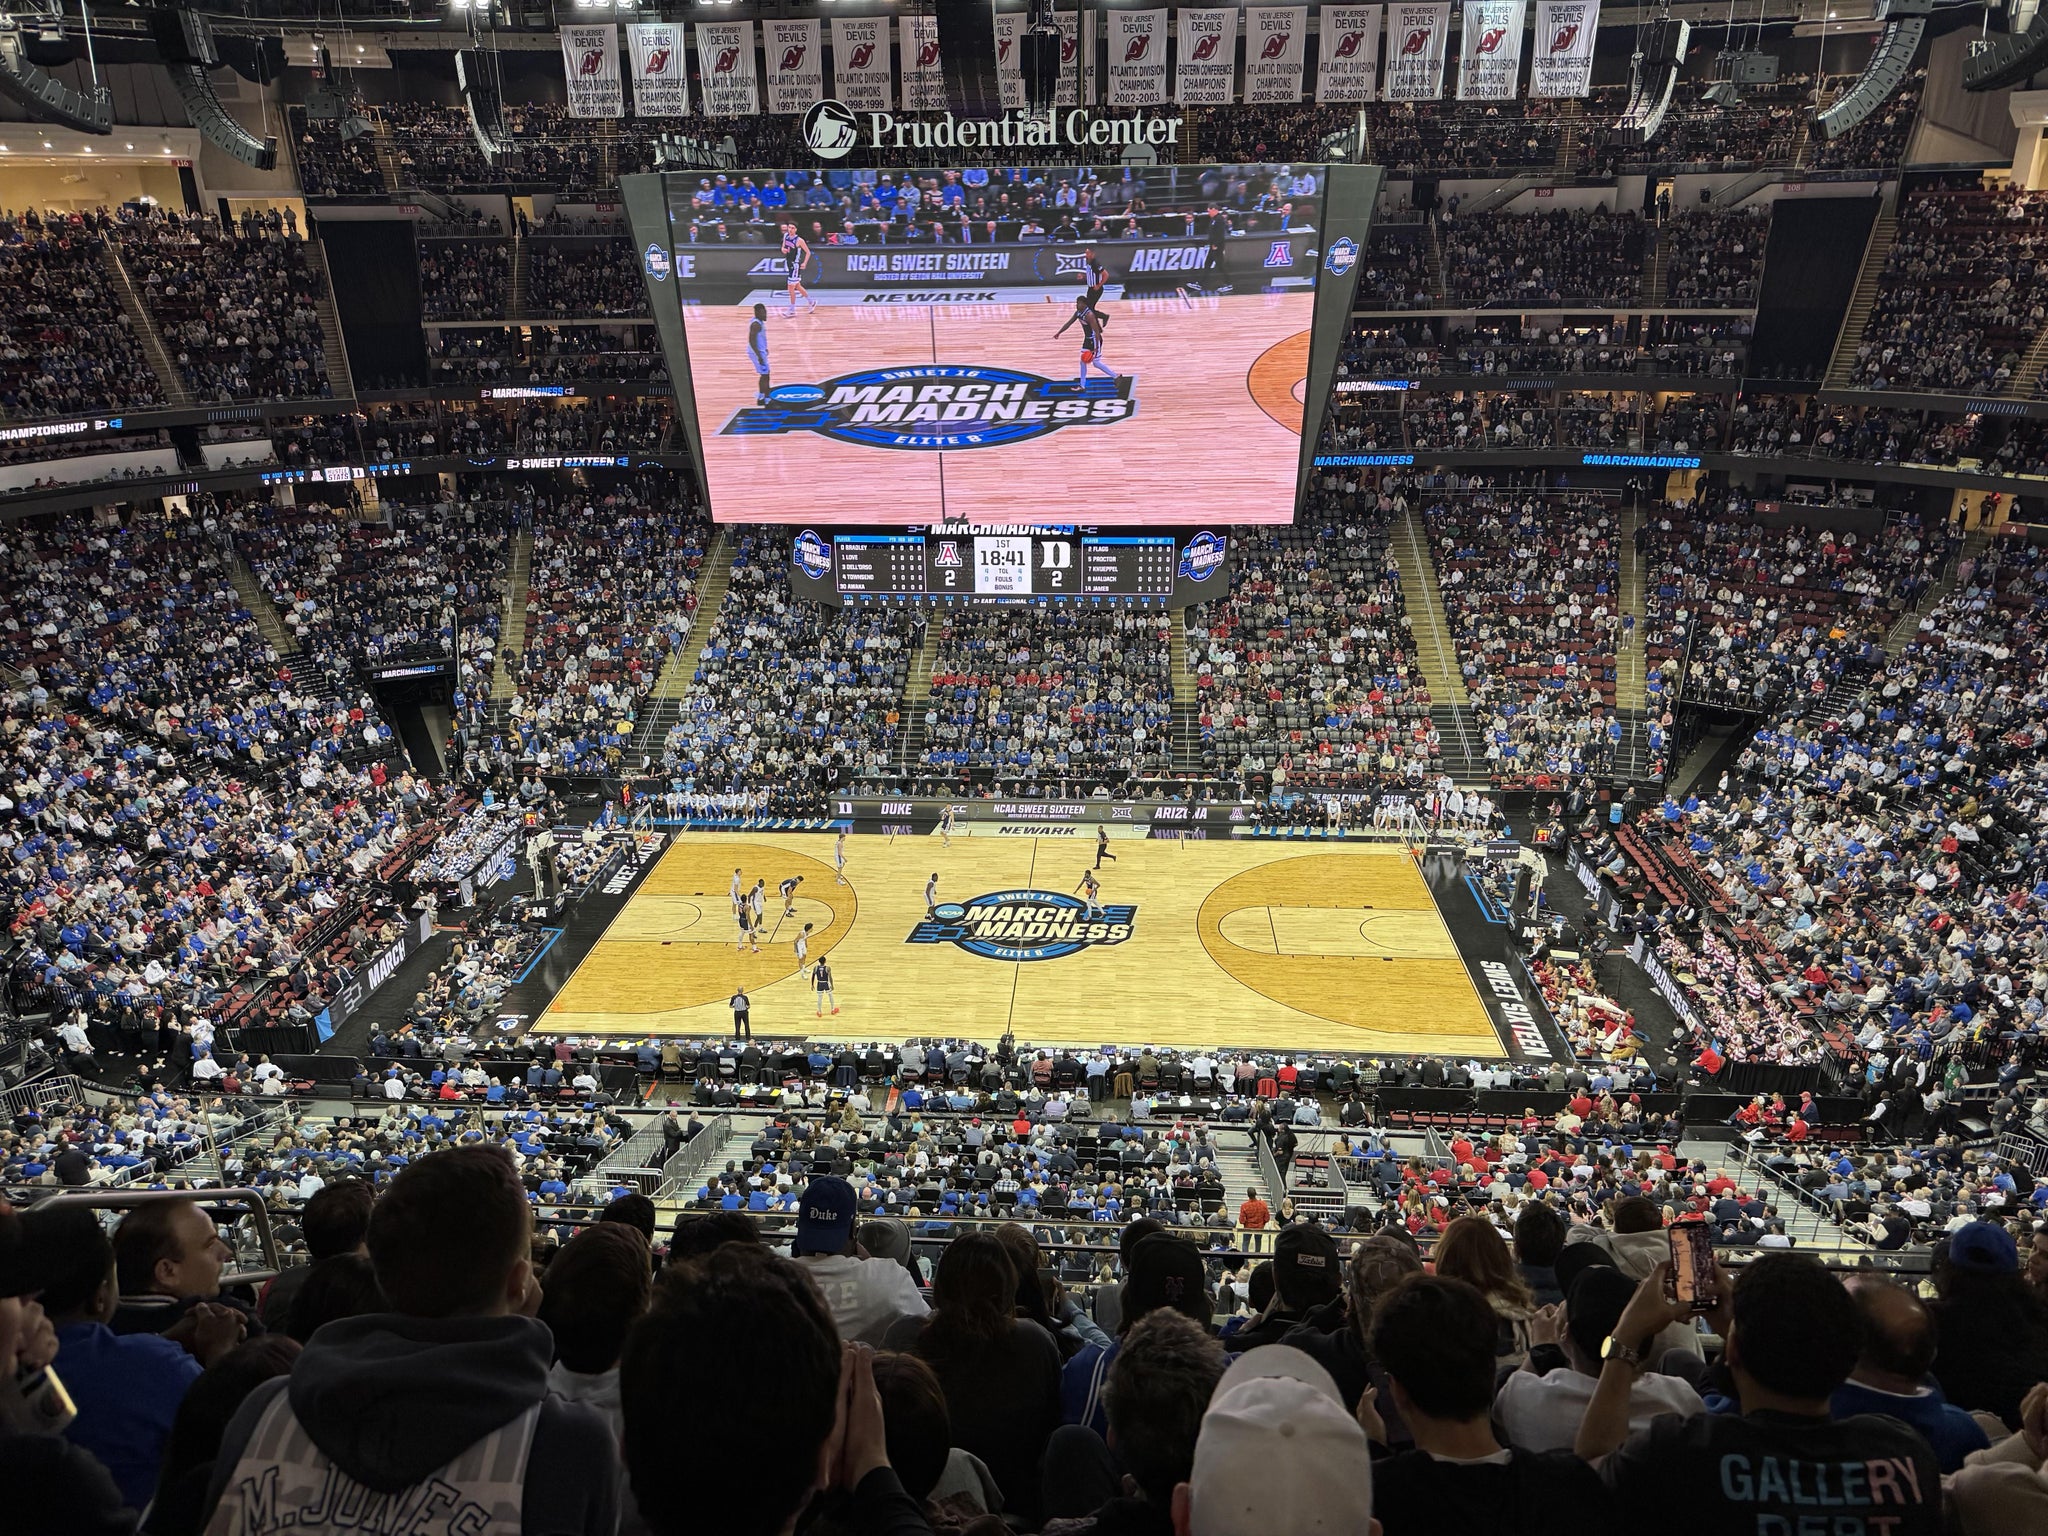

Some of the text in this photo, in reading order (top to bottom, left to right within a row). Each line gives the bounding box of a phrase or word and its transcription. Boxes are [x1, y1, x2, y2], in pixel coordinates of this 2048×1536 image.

[1403, 15, 1434, 26] DEVILS
[1478, 15, 1509, 25] DEVILS
[1551, 13, 1583, 23] DEVILS
[1123, 23, 1152, 33] DEVILS
[1192, 22, 1222, 31] DEVILS
[1261, 20, 1291, 30] DEVILS
[1335, 19, 1366, 29] DEVILS
[711, 35, 740, 45] DEVILS
[777, 32, 807, 42] DEVILS
[846, 31, 876, 40] DEVILS
[575, 38, 604, 47] DEVILS
[642, 37, 670, 46] DEVILS
[1320, 62, 1376, 73] ATLANTIC DIVISION
[1389, 59, 1443, 71] ATLANTIC DIVISION
[1462, 59, 1517, 70] ATLANTIC DIVISION
[1534, 57, 1591, 69] EASTERN CONFERENCE
[1110, 65, 1165, 77] ATLANTIC DIVISION
[1178, 64, 1232, 76] EASTERN CONFERENCE
[1247, 63, 1302, 75] ATLANTIC DIVISION
[769, 74, 821, 85] ATLANTIC DIVISION
[836, 72, 890, 84] ATLANTIC DIVISION
[1329, 76, 1364, 87] CHAMPIONS
[1396, 75, 1431, 86] CHAMPIONS
[1470, 73, 1506, 84] CHAMPIONS
[1540, 71, 1582, 82] CHAMPIONS
[594, 79, 620, 90] DIVISION
[634, 79, 685, 89] EASTERN CONFERENCE
[703, 78, 727, 88] ATLANTIC
[1120, 79, 1155, 91] CHAMPIONS
[1184, 78, 1226, 90] CHAMPIONS
[1256, 77, 1291, 89] CHAMPIONS
[713, 90, 747, 101] CHAMPIONS
[779, 89, 812, 99] CHAMPIONS
[846, 87, 881, 97] CHAMPIONS
[1252, 91, 1294, 100] 2005-2006
[1324, 90, 1368, 99] 2006-2007
[1465, 86, 1508, 96] 2009-2010
[1539, 85, 1581, 95] 2011-2012
[641, 92, 681, 103] CHAMPIONS
[1115, 93, 1160, 103] 2002-2003
[1183, 92, 1225, 101] 2002-2003
[641, 105, 681, 114] 1994-1995
[711, 103, 751, 113] 1996-1997
[868, 109, 1183, 148] Prudential Center
[847, 253, 1009, 271] NCAA SWEET SIXTEEN
[1129, 246, 1209, 272] ARIZON
[947, 272, 985, 280] UNIVERSITY
[861, 292, 997, 302] NEWARK
[881, 369, 978, 380] SWEET 16
[1336, 381, 1409, 391] MARCHMADNESS
[492, 387, 564, 399] MARCHMADNESS
[776, 391, 824, 400] NCAA
[827, 383, 1028, 404] MARCH
[849, 399, 1127, 424] MADNESS
[893, 434, 981, 445] ELITE 8
[522, 457, 615, 468] SWEET SIXTEEN
[1314, 455, 1414, 466] MARCHMADNESS
[1582, 455, 1701, 468] #MARCHMADNESS
[931, 524, 1074, 535] MARCHMADNESS
[801, 541, 821, 555] MARCH
[996, 540, 1010, 548] 1ST
[1190, 543, 1214, 558] MARCH
[804, 552, 831, 569] MADNESS
[981, 550, 1025, 566] 18:41
[1192, 550, 1224, 567] MADNESS
[945, 569, 956, 586] 2
[1051, 570, 1063, 587] 2
[381, 664, 436, 678] MARCHMADNESS
[881, 803, 912, 815] DUKE
[993, 804, 1086, 815] NCAA SWEET SIXTEEN
[999, 826, 1077, 835] NEWARK
[477, 834, 516, 886] MADNESS
[602, 864, 639, 895] SWEET
[1577, 862, 1602, 901] MARCH
[997, 893, 1038, 901] SWEET
[963, 906, 1078, 923] MARCH
[974, 921, 1131, 939] MADNESS
[994, 949, 1030, 957] ELITE
[368, 937, 406, 991] MARCH
[1644, 952, 1690, 1018] MADNESS
[1480, 960, 1553, 1058] SWEET SIXTEEN
[810, 1207, 838, 1221] Duke
[1720, 1454, 1923, 1505] GALLERY
